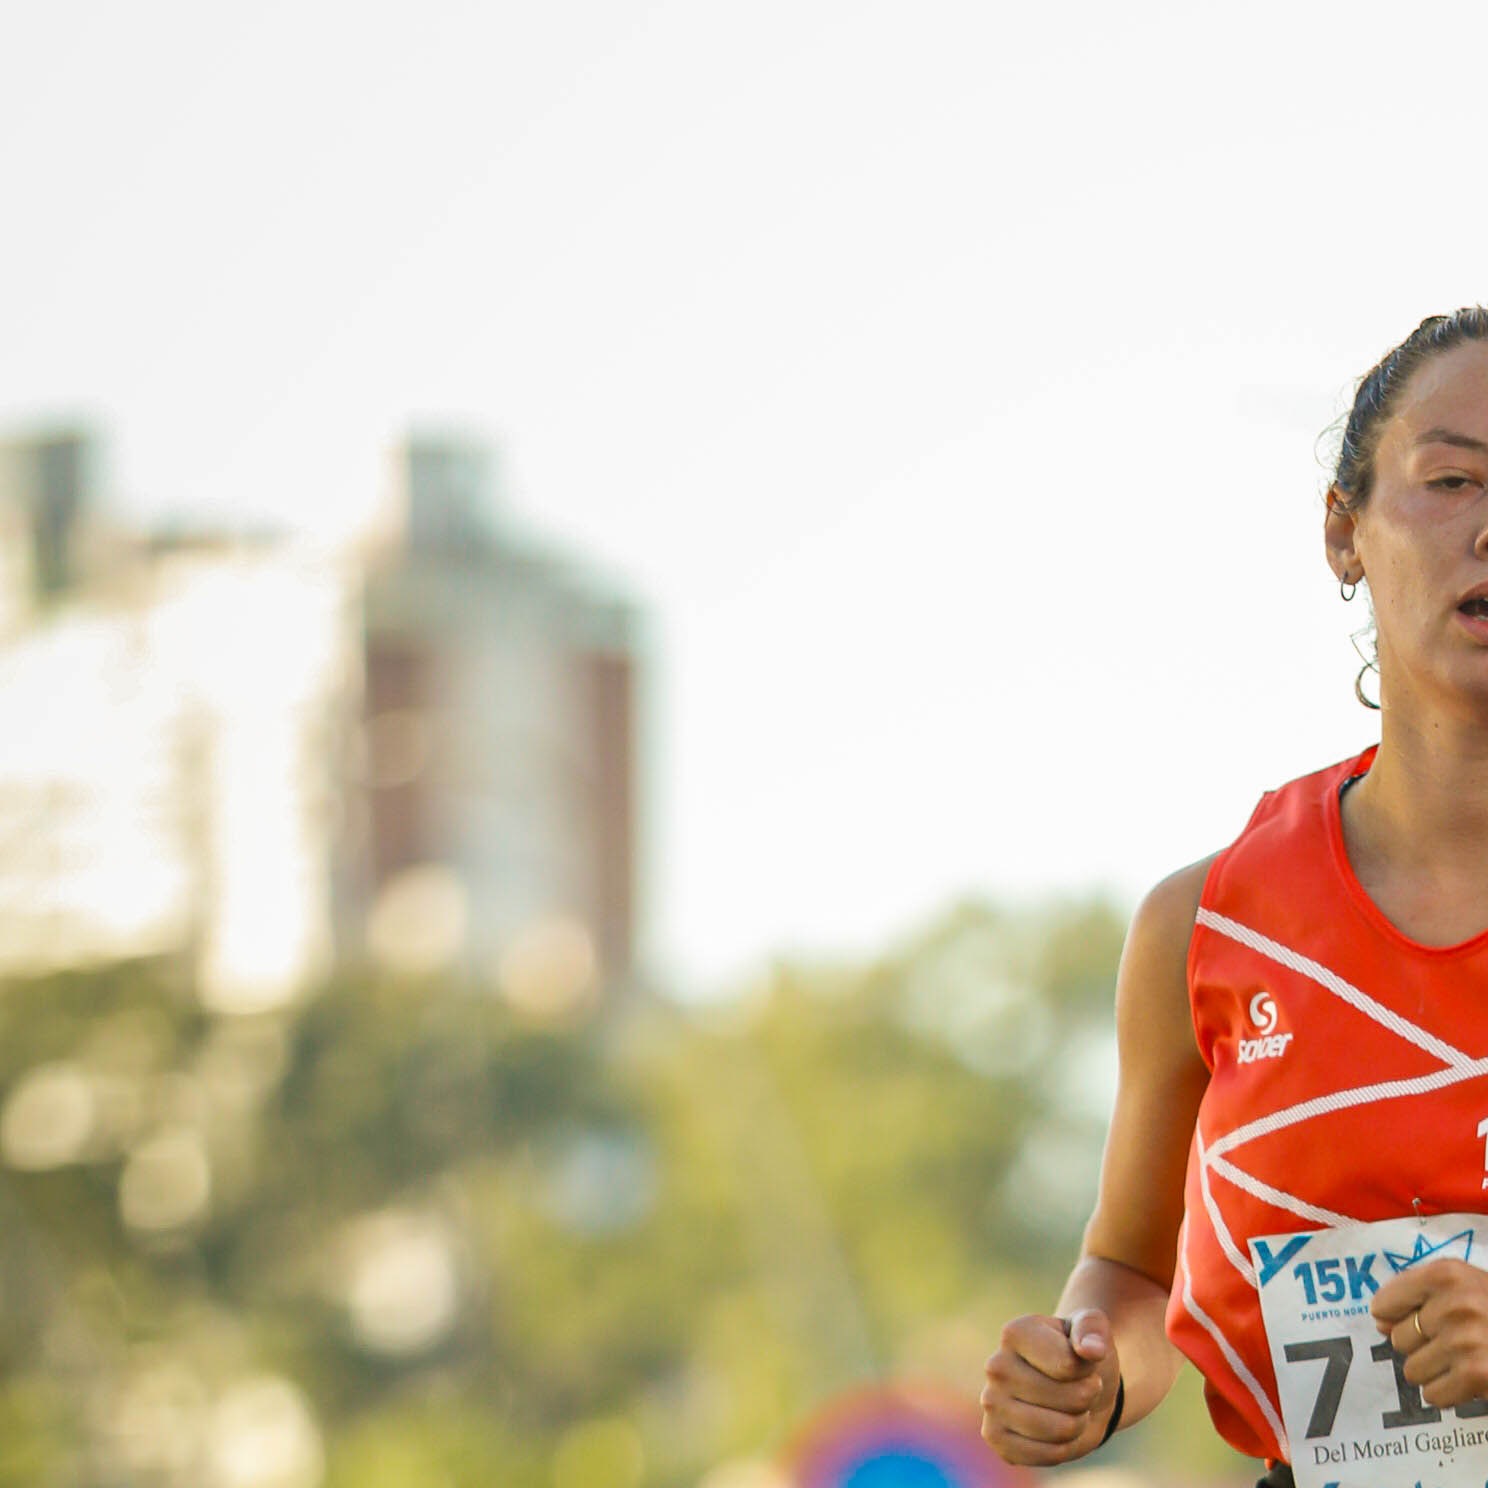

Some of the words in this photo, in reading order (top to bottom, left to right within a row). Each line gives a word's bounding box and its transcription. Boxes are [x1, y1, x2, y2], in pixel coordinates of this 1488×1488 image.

[1293, 1252, 1380, 1304] 15K
[1301, 1309, 1341, 1321] PUERTO
[1343, 1304, 1369, 1316] NORT
[1313, 1445, 1347, 1465] Del
[1353, 1435, 1409, 1461] Moral
